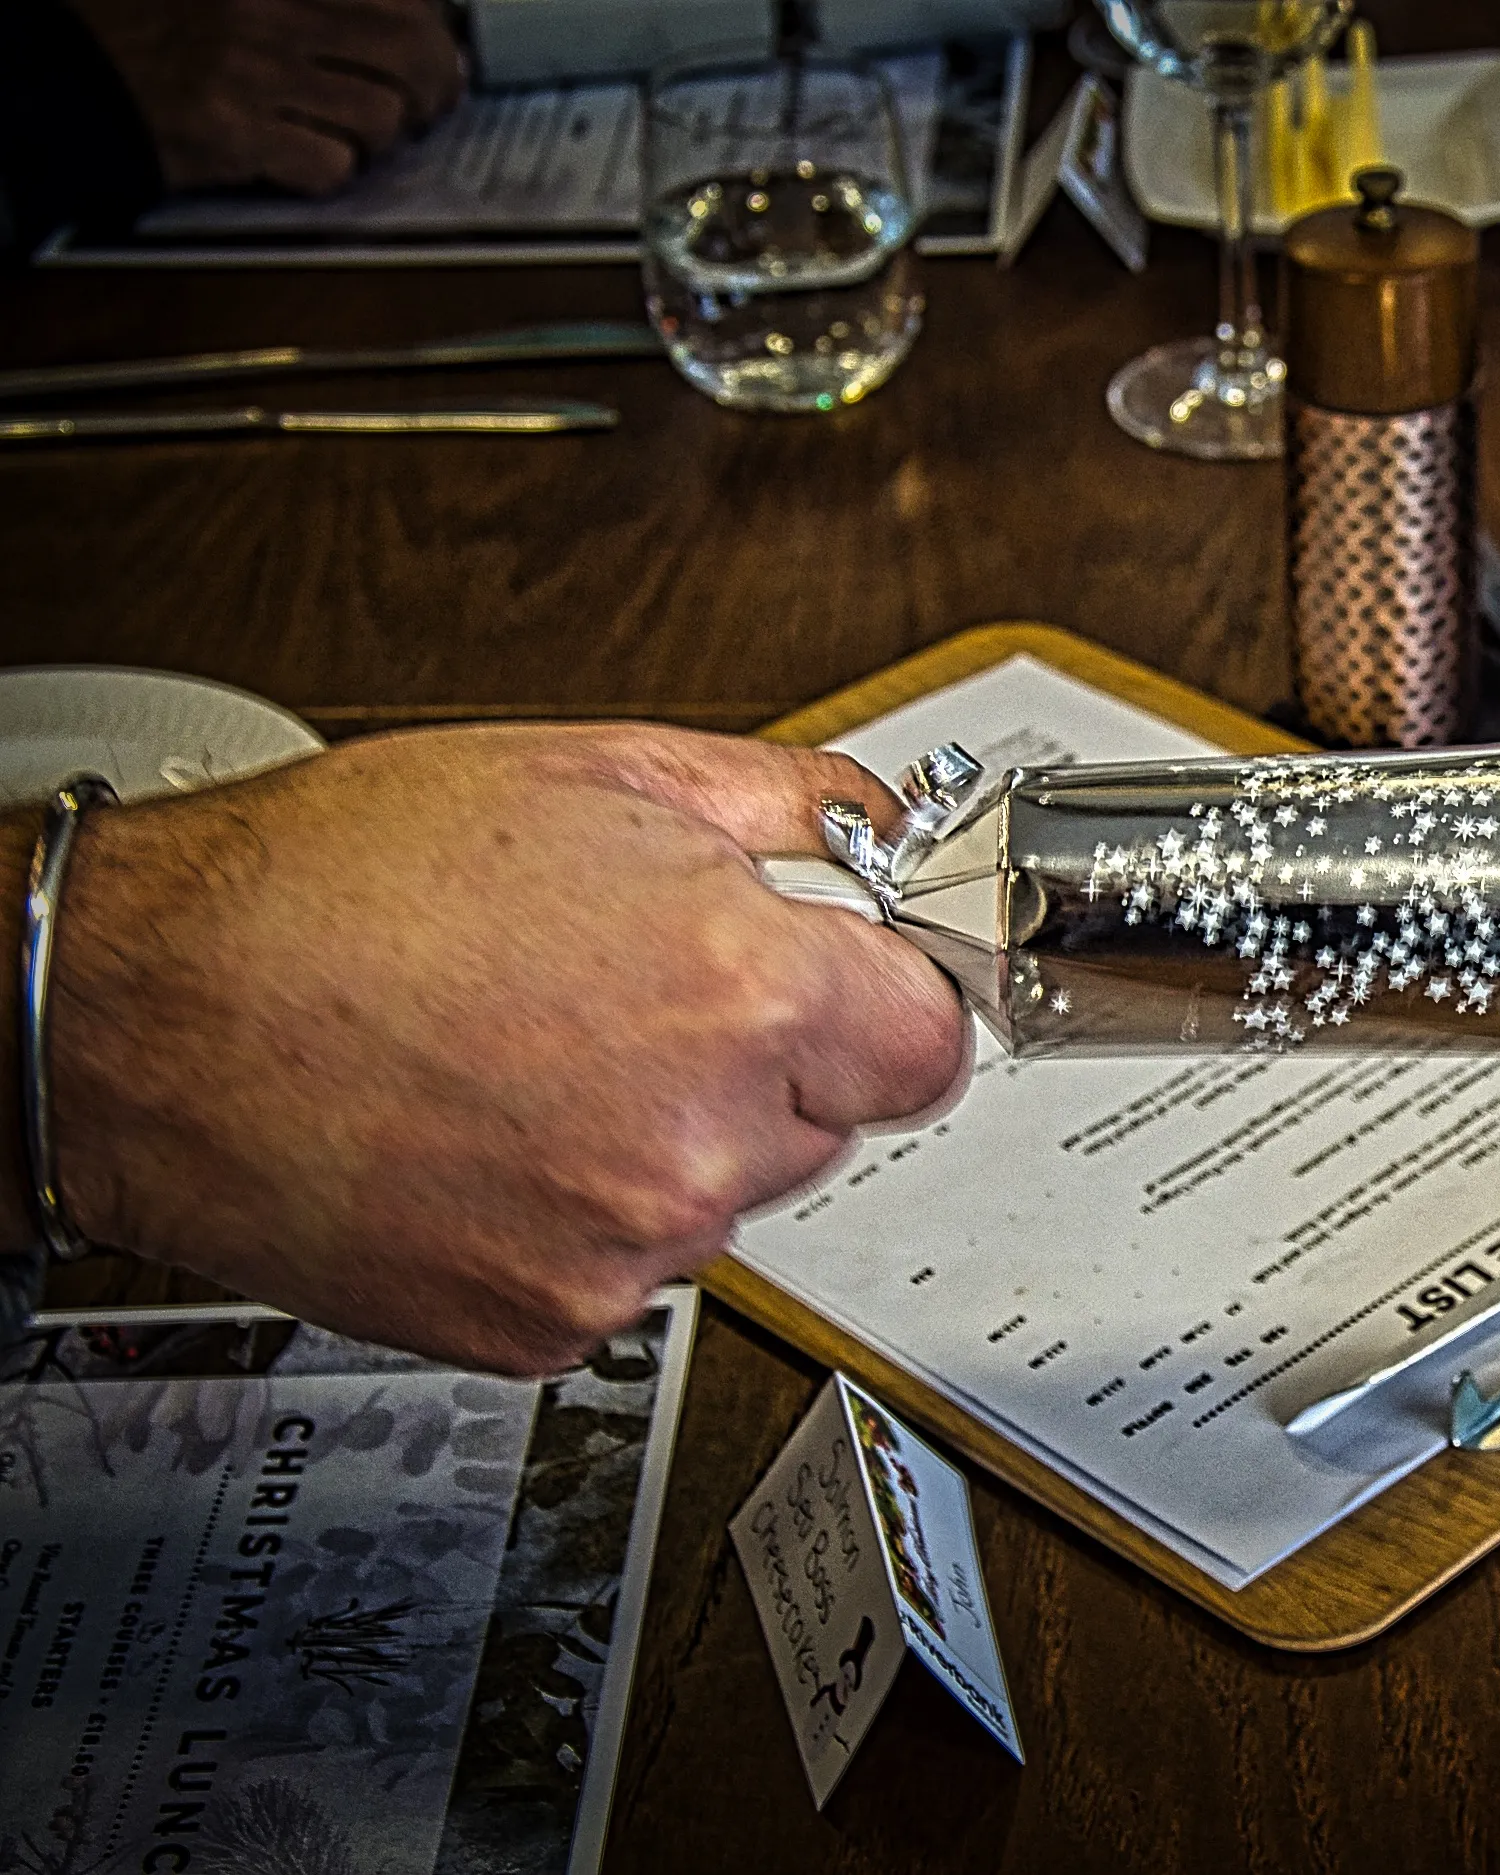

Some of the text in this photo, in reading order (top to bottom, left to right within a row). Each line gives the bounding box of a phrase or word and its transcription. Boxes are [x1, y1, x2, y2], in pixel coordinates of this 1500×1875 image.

[1395, 1260, 1494, 1332] LIST
[130, 1537, 165, 1596] THREE
[196, 1416, 316, 1704] CHRISTMAS
[31, 1601, 85, 1710] STARTERS
[100, 1602, 142, 1690] COURSES
